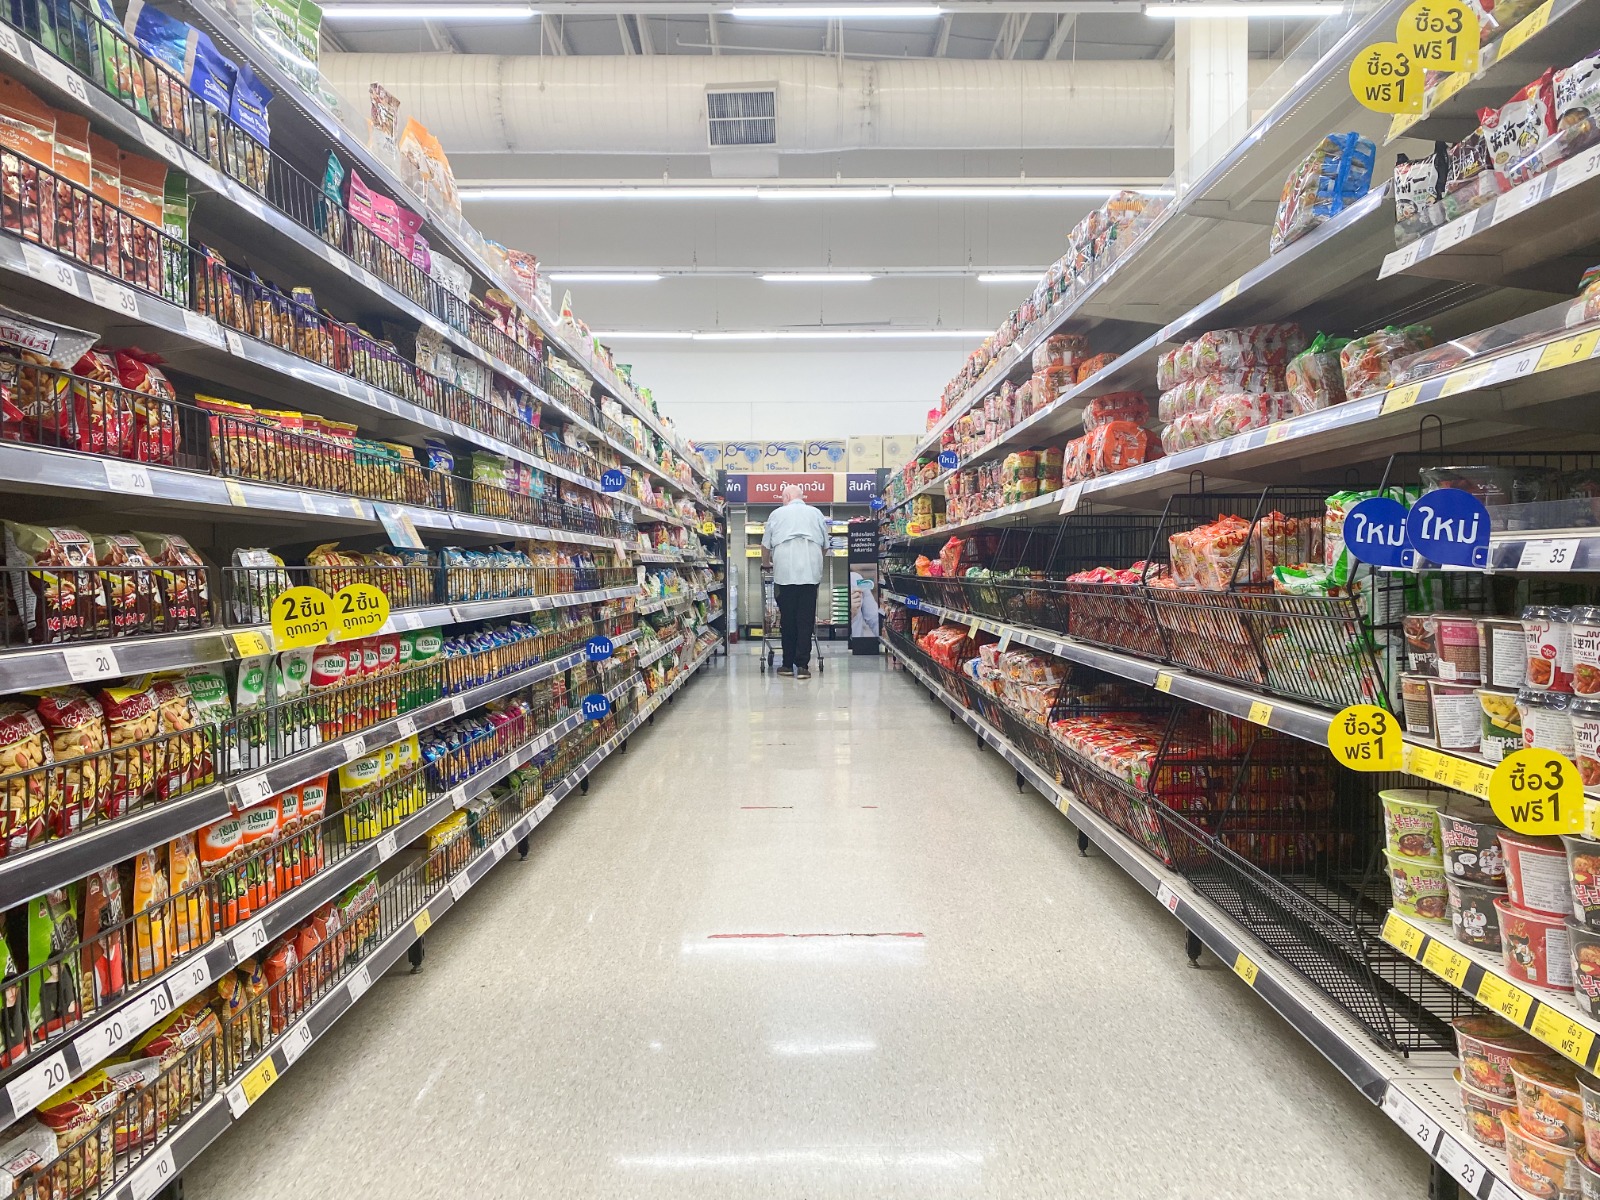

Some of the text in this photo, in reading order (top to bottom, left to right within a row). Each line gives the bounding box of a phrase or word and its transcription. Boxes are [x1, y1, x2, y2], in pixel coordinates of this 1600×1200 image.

[66, 75, 86, 100] 65
[1526, 182, 1542, 204] 31
[1454, 224, 1466, 240] 31
[1402, 252, 1412, 266] 31
[57, 264, 72, 286] 39
[119, 291, 136, 312] 39
[1572, 344, 1582, 358] 9
[1515, 359, 1530, 374] 10
[132, 474, 145, 488] 20
[756, 483, 776, 492] ครบ
[1418, 506, 1480, 544] ใหม่
[1550, 548, 1566, 564] 35
[285, 619, 328, 640] ถูกกว่า
[343, 612, 382, 631] ถูกกว่า
[254, 640, 264, 650] 15
[589, 642, 610, 654] ใหม่
[96, 658, 110, 672] 20
[584, 700, 606, 713] ใหม่
[258, 782, 271, 796] 20
[252, 929, 265, 946] 20
[192, 968, 204, 986] 20
[150, 994, 166, 1016] 20
[105, 1022, 123, 1046] 20
[300, 1026, 310, 1044] 10
[44, 1066, 64, 1090] 20
[262, 1069, 271, 1084] 18
[1417, 1124, 1430, 1142] 23
[156, 1159, 168, 1178] 10
[1462, 1164, 1476, 1183] 23
